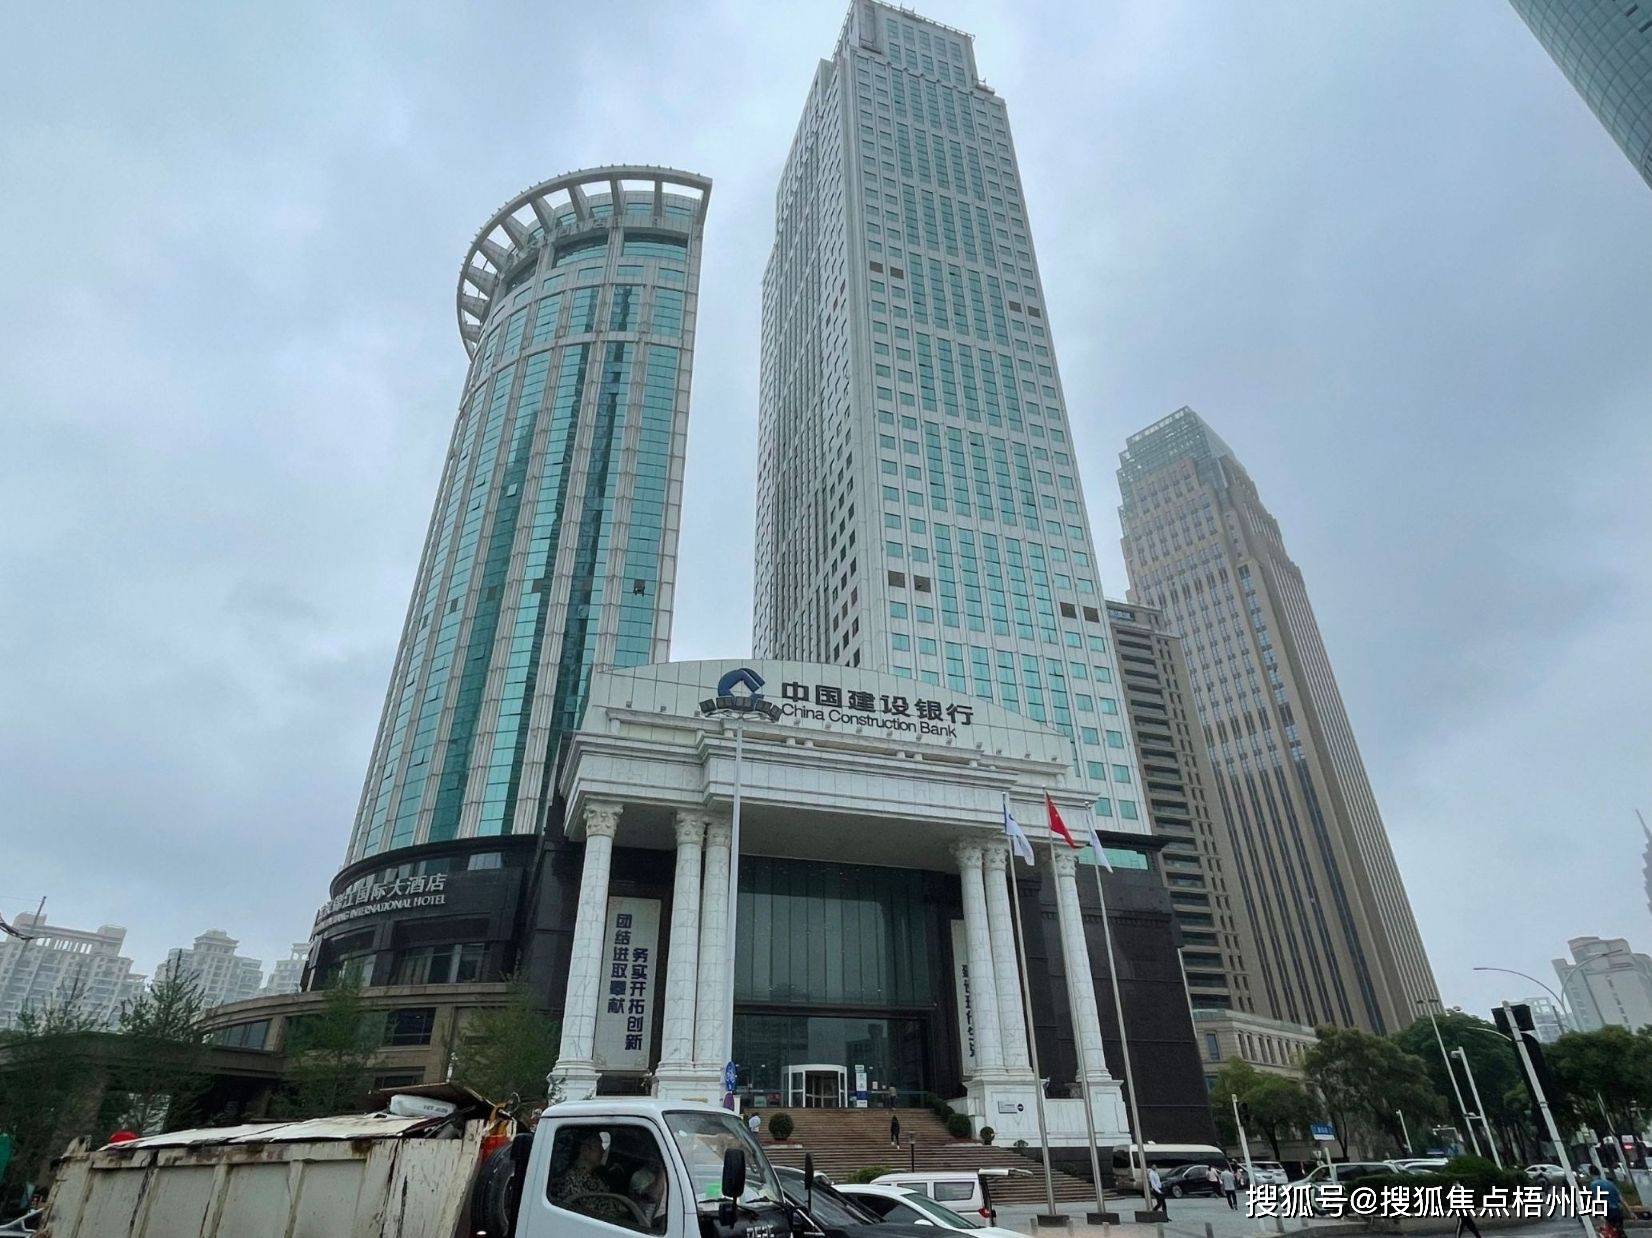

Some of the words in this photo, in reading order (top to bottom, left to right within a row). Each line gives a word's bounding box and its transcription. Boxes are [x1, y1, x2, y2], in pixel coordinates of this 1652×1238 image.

[781, 681, 973, 726] 中国建设银行
[781, 703, 825, 721] China
[828, 709, 917, 733] Construction
[920, 721, 958, 738] Bank
[350, 899, 411, 919] INTERNATIONAL
[413, 894, 446, 907] HOTEL
[607, 913, 633, 1014] 团结进取献
[624, 947, 649, 1051] 务实开拓创新
